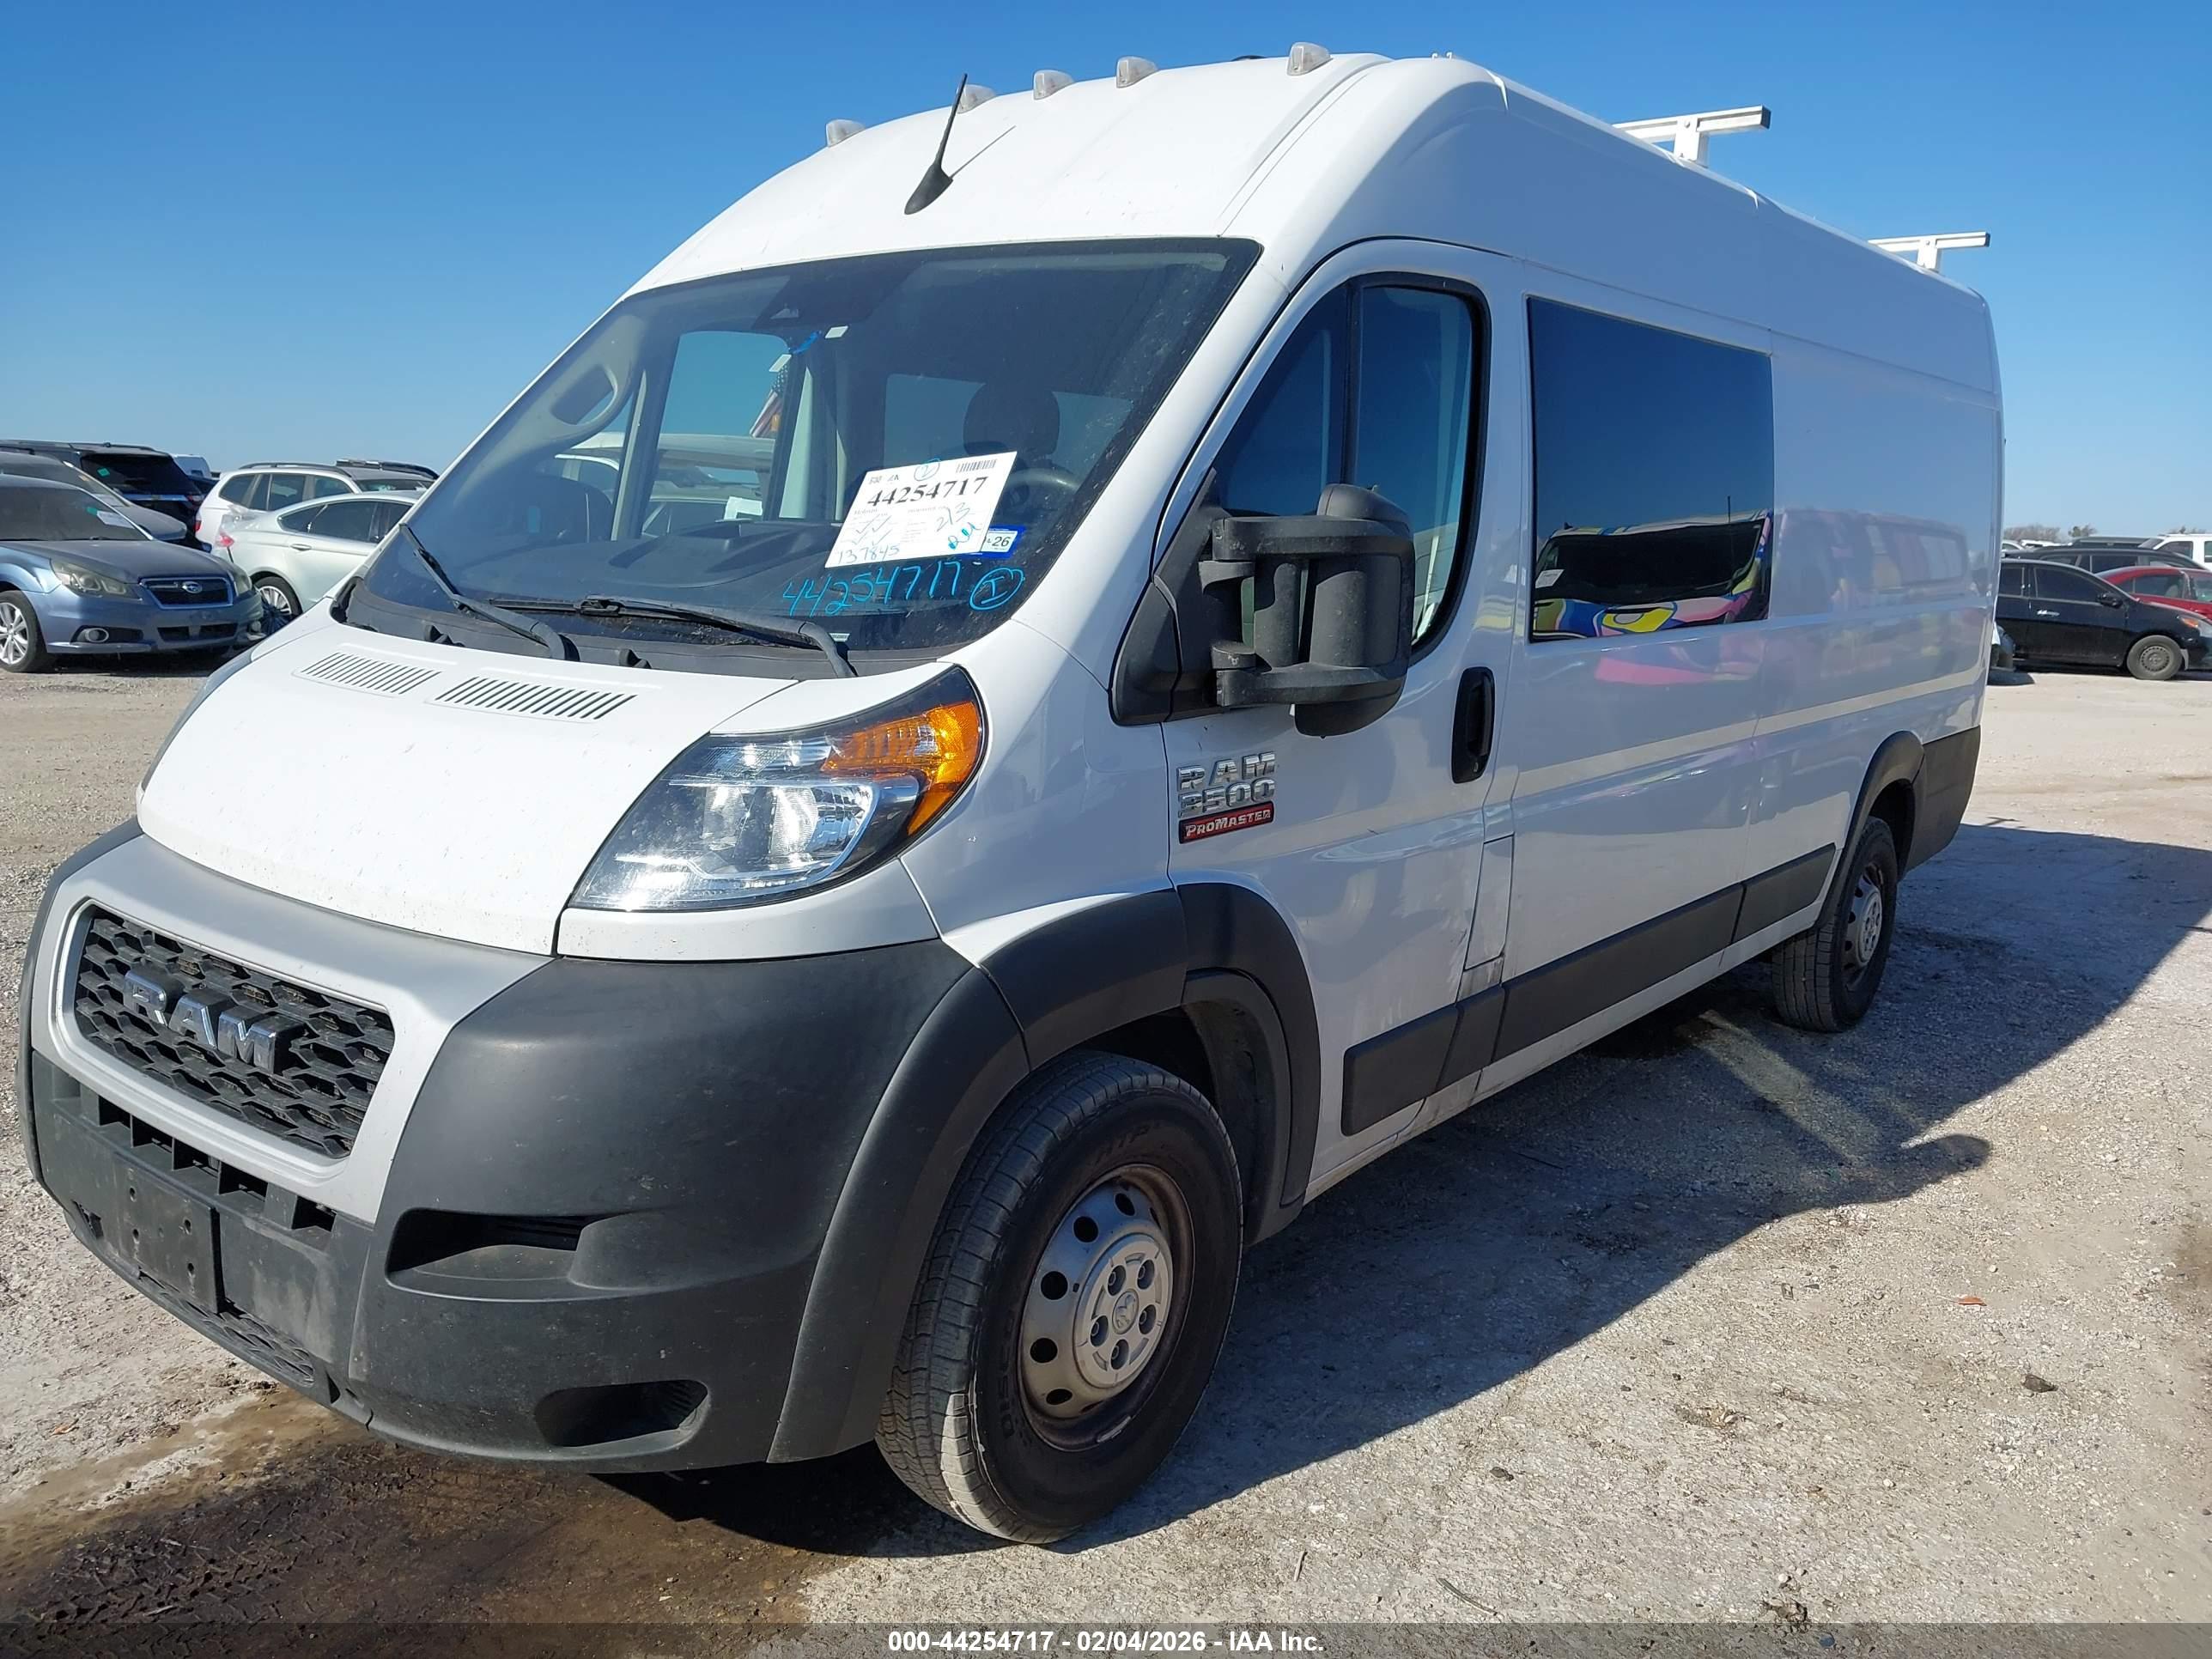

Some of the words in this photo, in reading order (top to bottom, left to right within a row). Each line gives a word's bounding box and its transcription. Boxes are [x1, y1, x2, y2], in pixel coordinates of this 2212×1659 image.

[867, 477, 989, 507] 44254717
[991, 536, 1012, 547] 26
[782, 562, 963, 617] 44254717
[1176, 751, 1276, 792] RAM
[1178, 776, 1275, 818] 3500
[124, 962, 292, 1074] RAM
